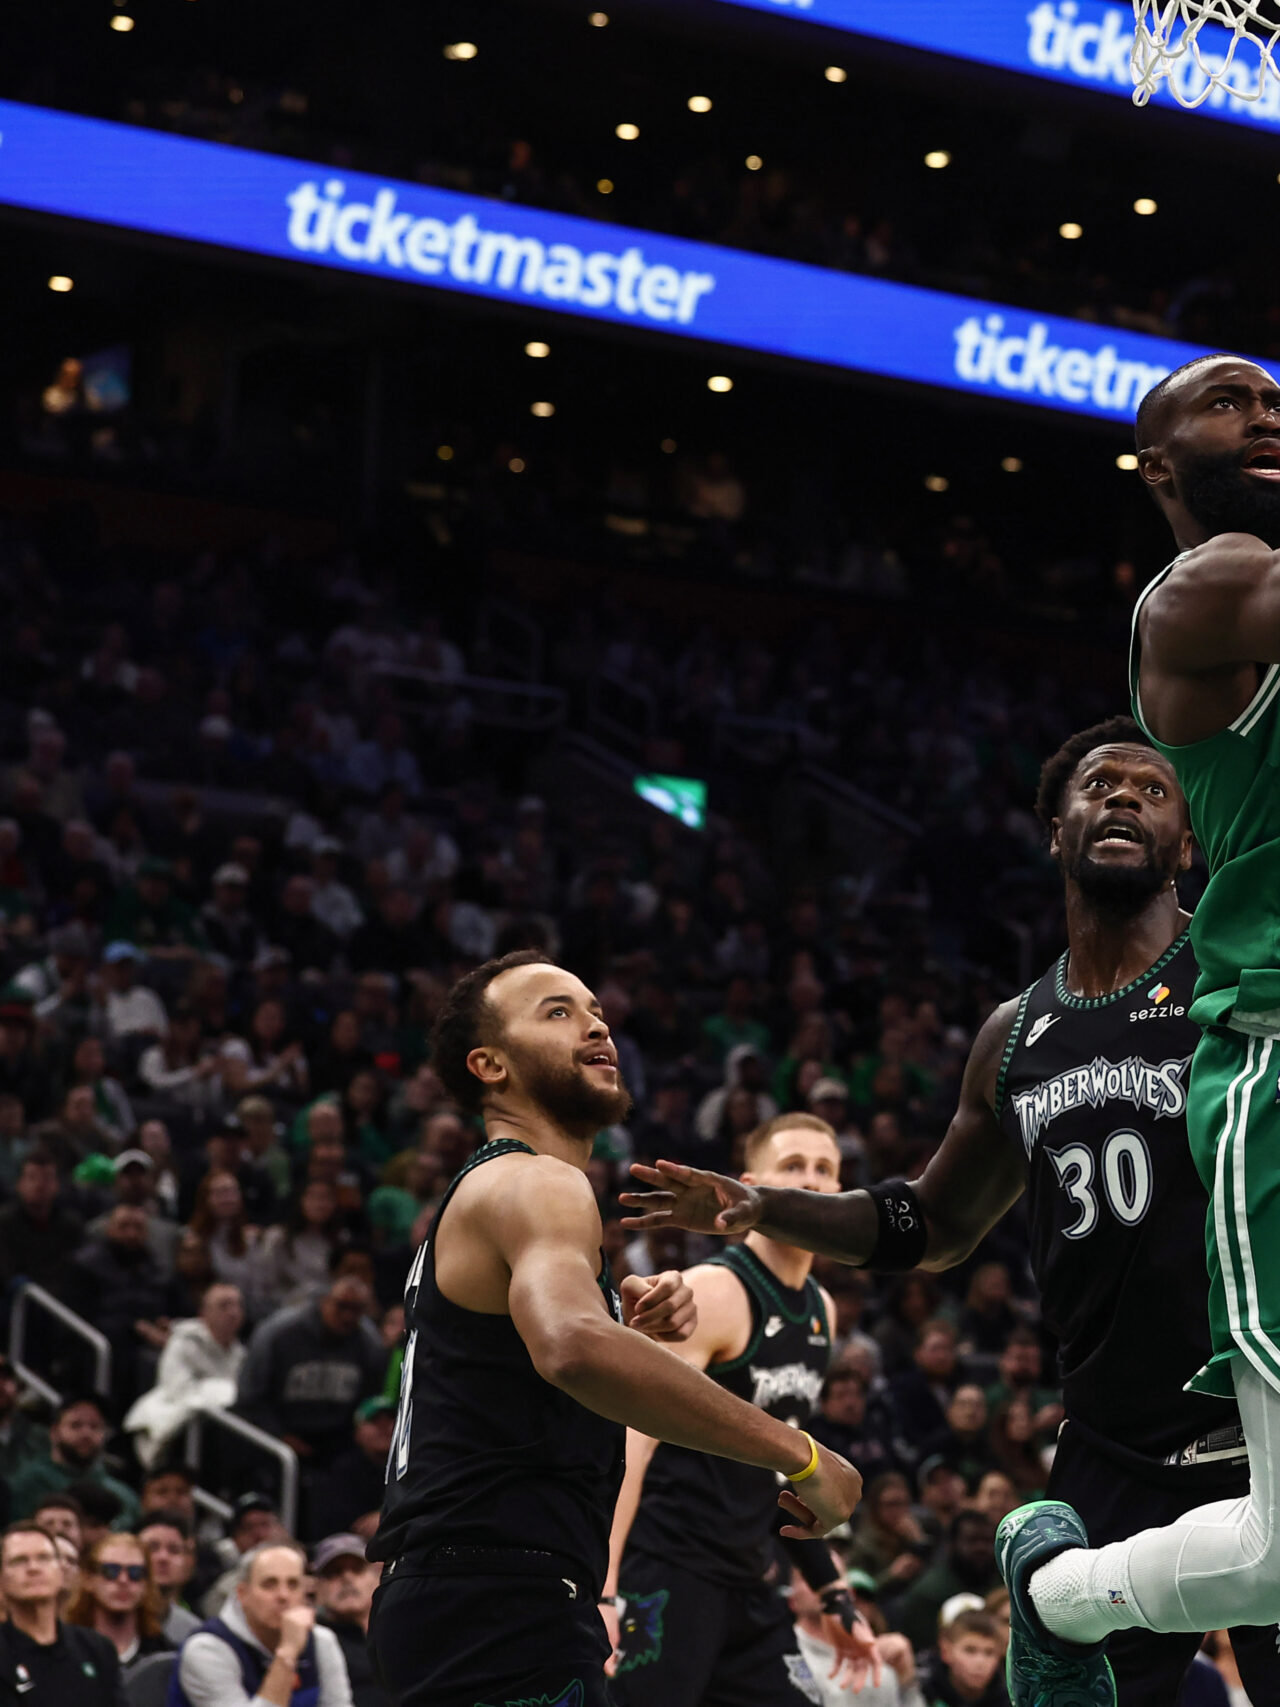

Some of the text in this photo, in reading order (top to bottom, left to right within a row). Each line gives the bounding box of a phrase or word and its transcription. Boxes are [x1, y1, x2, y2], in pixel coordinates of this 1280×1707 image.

[287, 179, 714, 324] ticketmaster
[1129, 1003, 1185, 1022] sezzle
[1011, 1055, 1193, 1160] TIMBERWOLVES
[1043, 1128, 1154, 1240] 30
